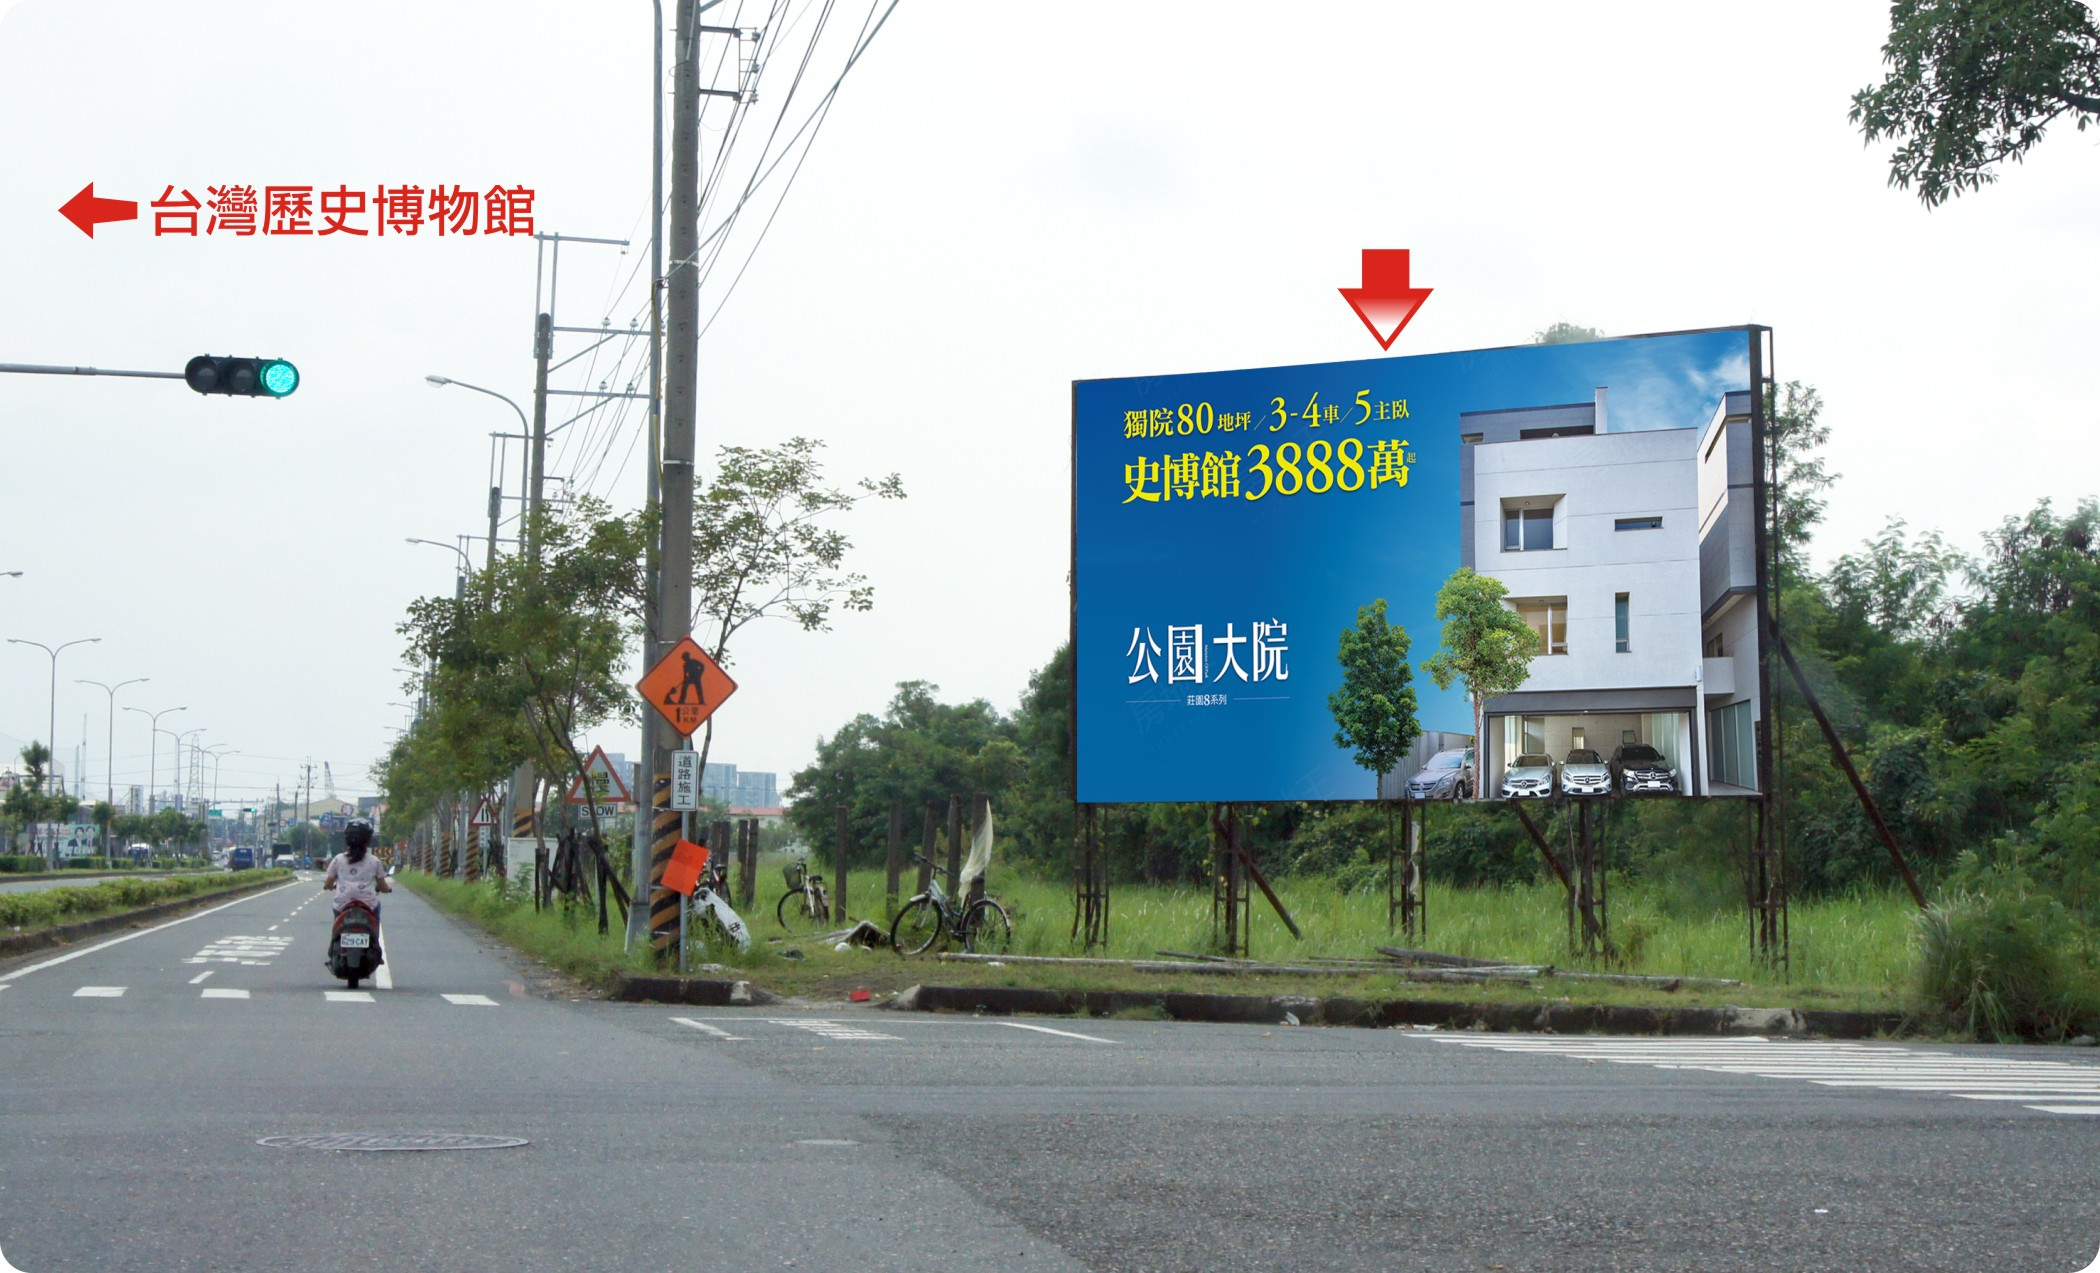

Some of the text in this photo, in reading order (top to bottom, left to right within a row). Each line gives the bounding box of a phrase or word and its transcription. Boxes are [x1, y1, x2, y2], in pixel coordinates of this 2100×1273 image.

[1125, 617, 1289, 685] 公園大院
[677, 756, 691, 806] 道路施工
[581, 805, 615, 816] SOW
